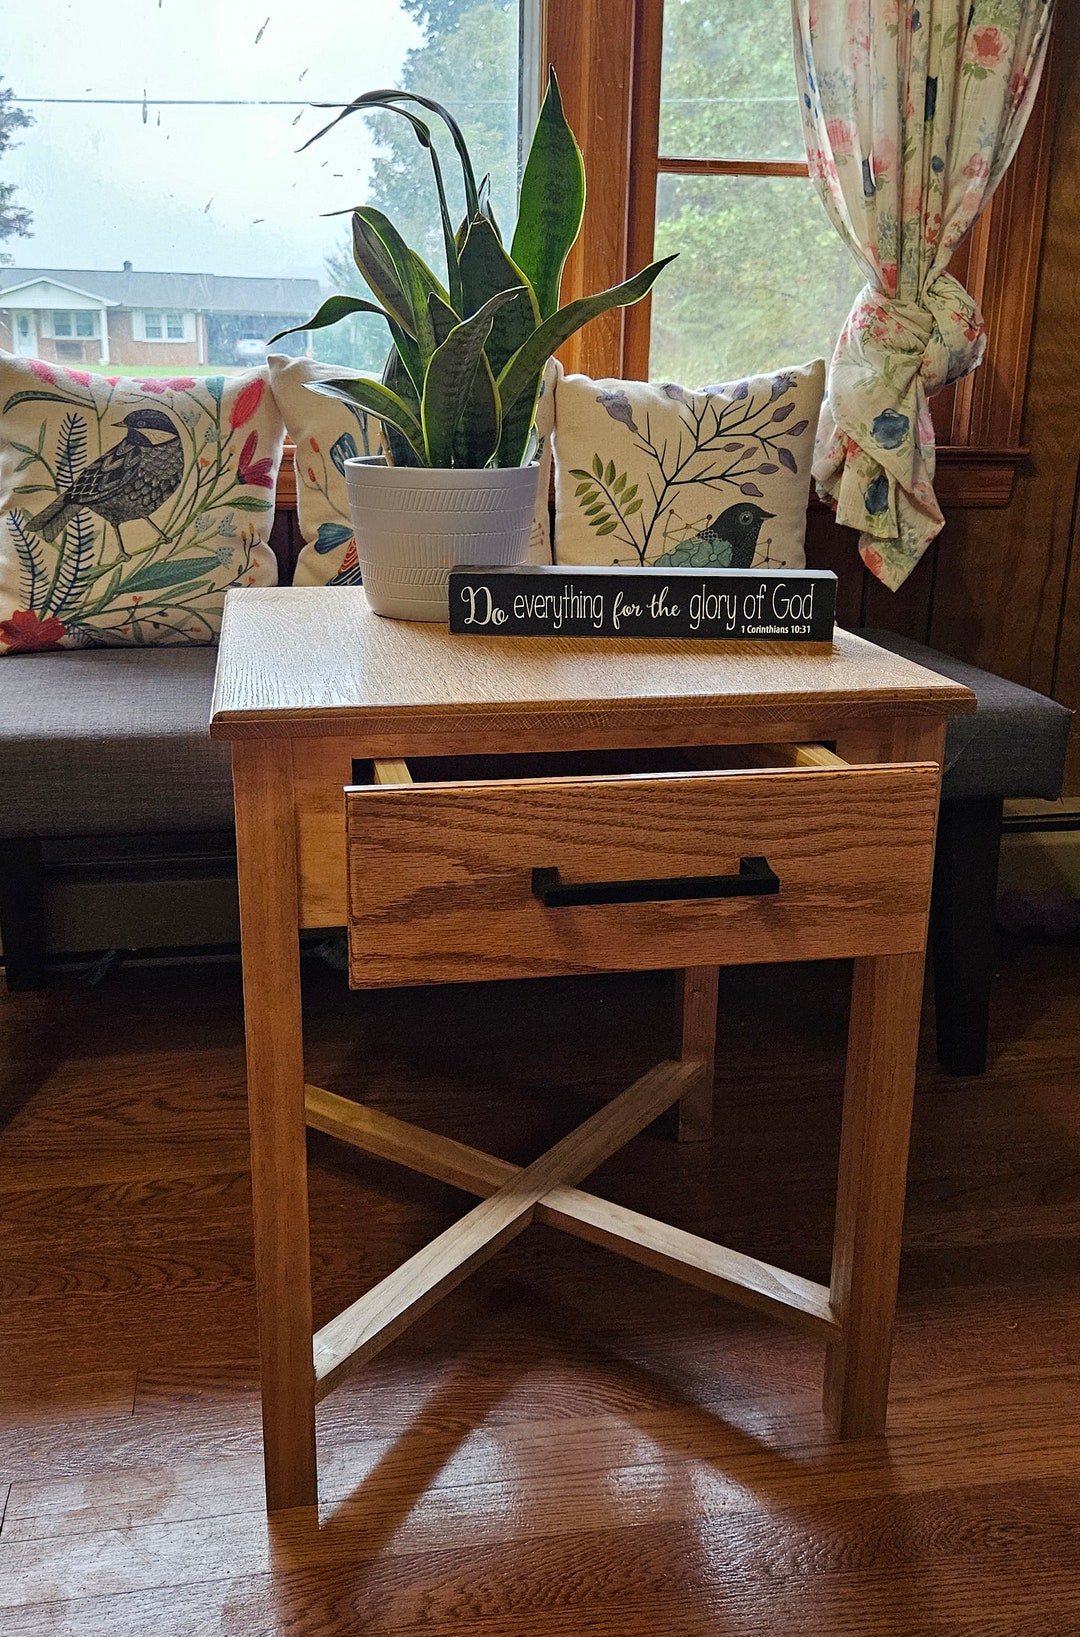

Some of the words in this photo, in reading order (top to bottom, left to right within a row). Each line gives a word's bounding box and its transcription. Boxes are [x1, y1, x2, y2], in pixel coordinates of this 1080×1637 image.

[460, 586, 509, 626] Do
[513, 584, 604, 629] everything
[612, 591, 644, 630] for
[645, 586, 681, 619] the
[689, 583, 737, 631] glory
[743, 583, 767, 620] of
[772, 583, 815, 620] God
[741, 625, 746, 634] 1
[746, 624, 789, 635] Corinthians
[790, 625, 811, 635] 10:31
